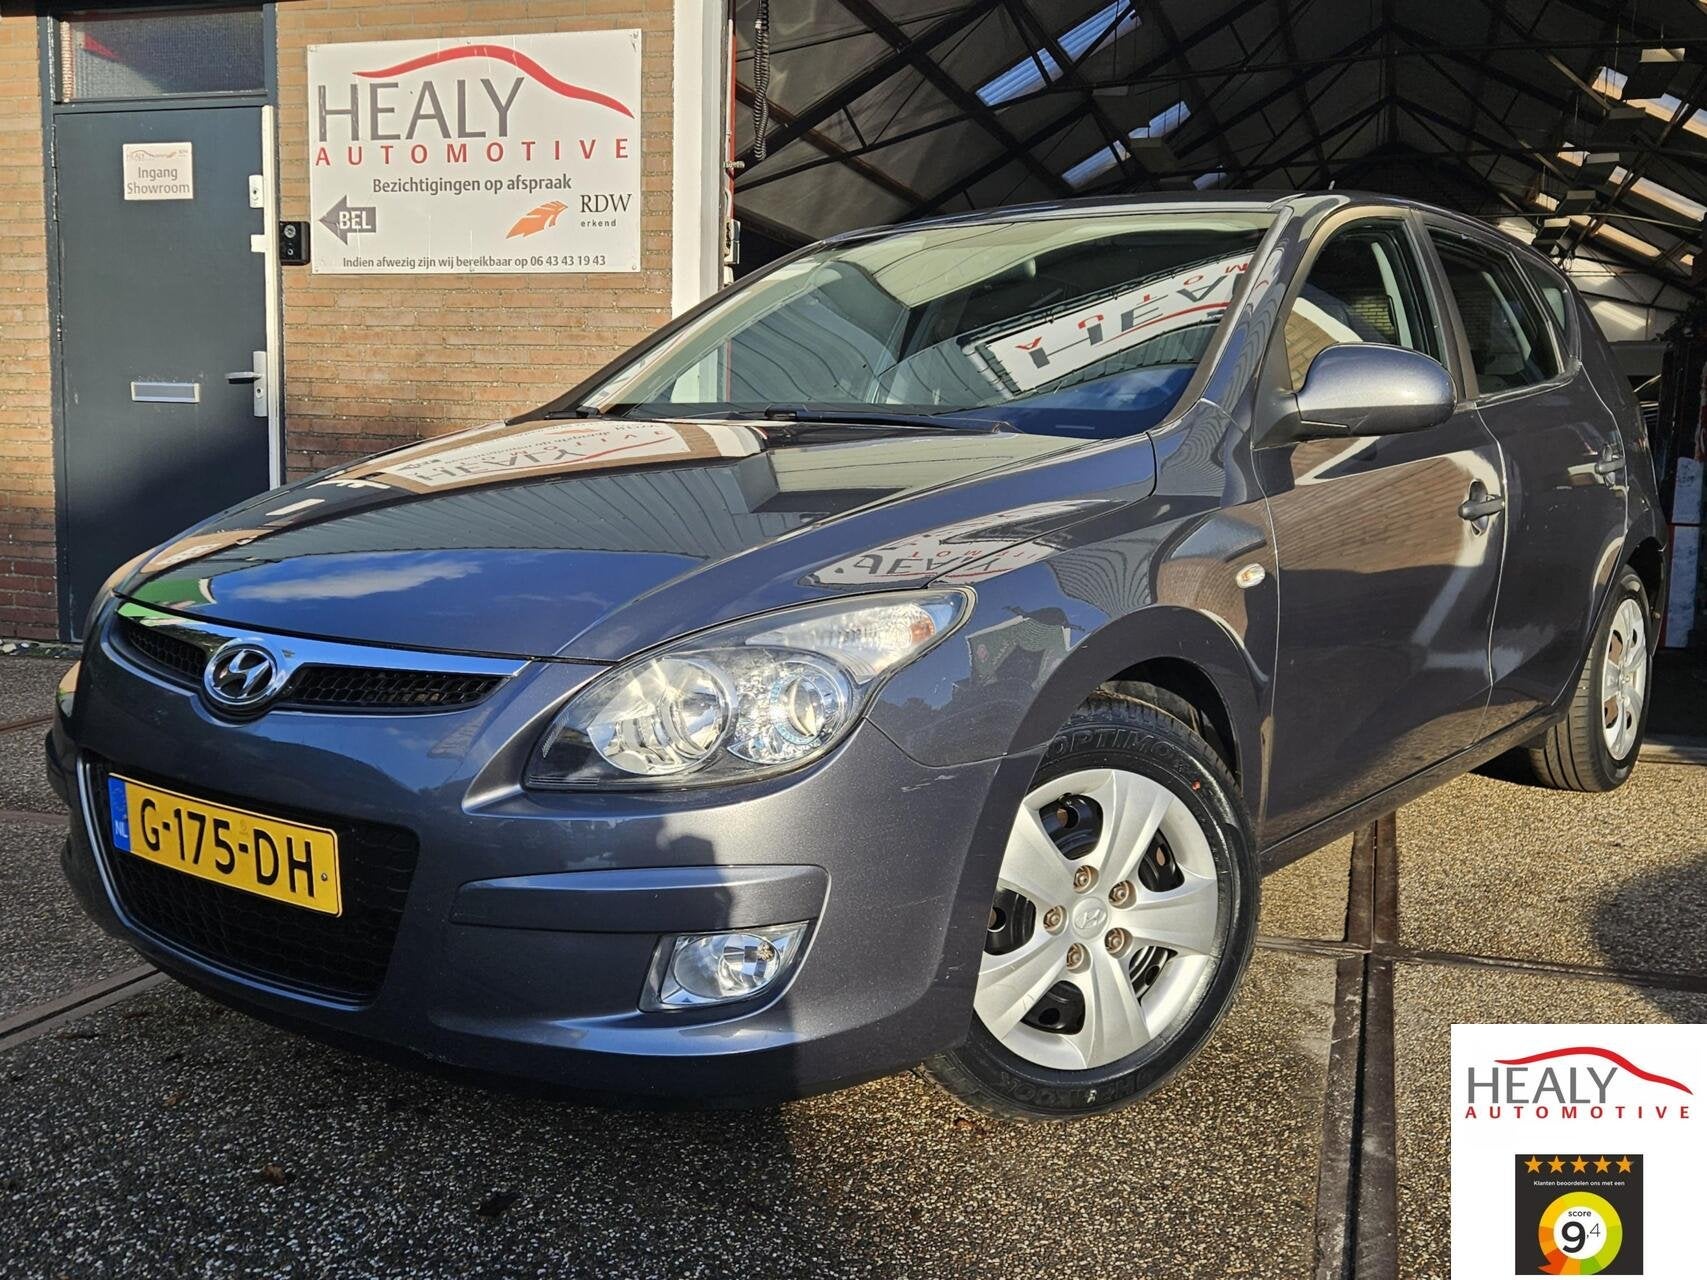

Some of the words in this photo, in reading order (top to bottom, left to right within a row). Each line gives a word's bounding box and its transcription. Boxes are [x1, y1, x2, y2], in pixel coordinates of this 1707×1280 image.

[317, 76, 525, 142] HEALY
[315, 138, 629, 166] AUTOMOTIVE
[138, 166, 178, 181] Ingang
[127, 181, 190, 194] Showroom
[373, 176, 481, 196] Bezichtigingen
[484, 179, 503, 195] op
[506, 173, 572, 192] afspraak
[339, 210, 372, 230] BEL
[580, 193, 632, 213] RDW
[580, 218, 617, 228] erkend
[343, 256, 374, 268] Indien
[376, 256, 416, 269] afwezig
[417, 256, 436, 269] zijn
[437, 256, 454, 269] wij
[456, 255, 512, 268] bereikbaar
[514, 257, 528, 269] op
[530, 255, 544, 266] 06
[545, 255, 559, 266] 43
[561, 255, 575, 266] 43
[577, 255, 590, 266] 19
[592, 255, 606, 266] 43
[114, 821, 128, 838] NL
[140, 798, 316, 898] G-175-DH
